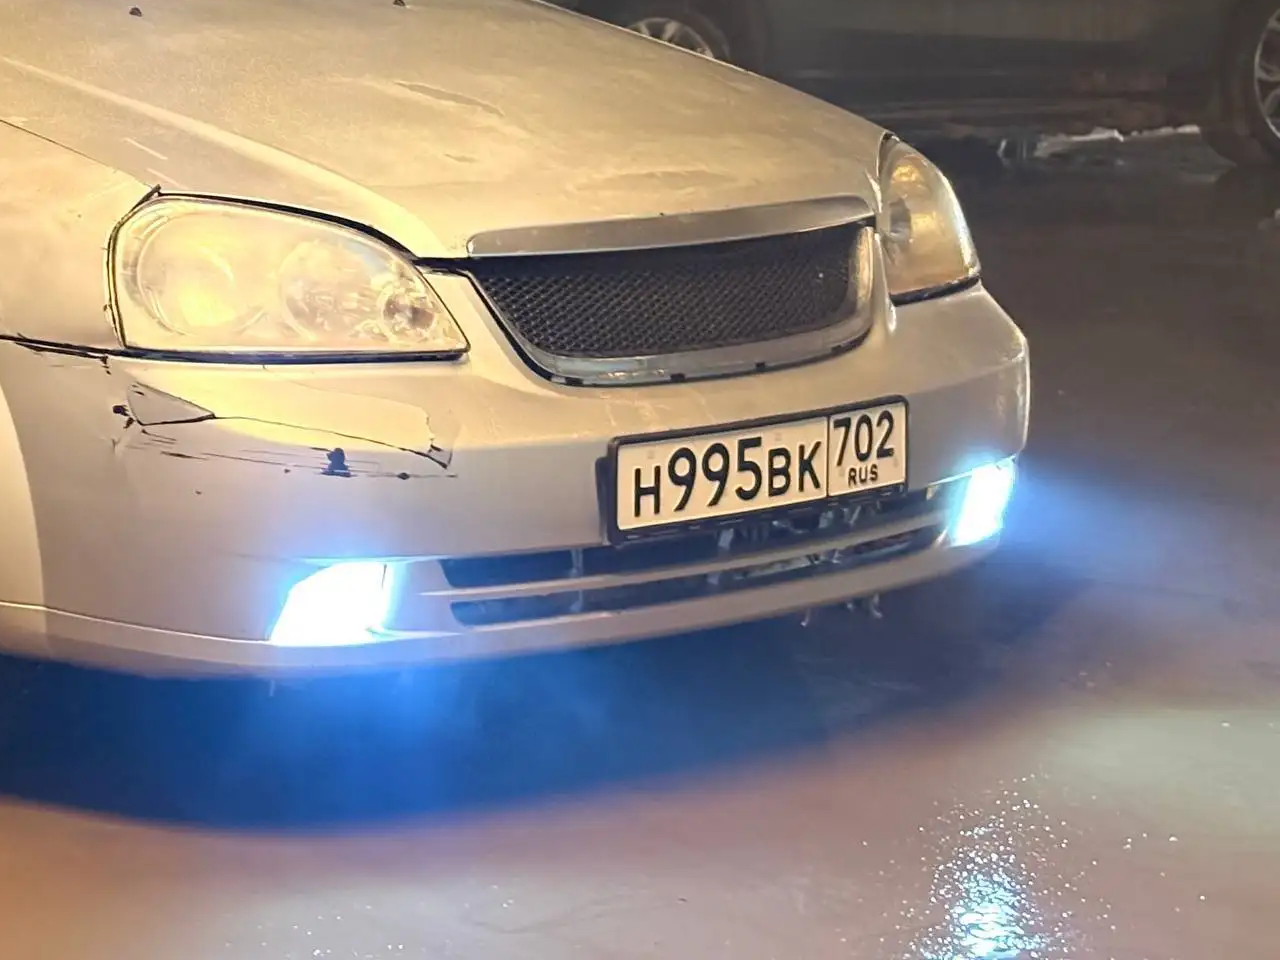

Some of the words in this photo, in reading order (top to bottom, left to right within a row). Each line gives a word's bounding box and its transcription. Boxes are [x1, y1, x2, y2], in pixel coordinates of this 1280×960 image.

[633, 436, 822, 518] Н995ВК
[833, 410, 895, 467] 702
[848, 464, 878, 487] RUS
